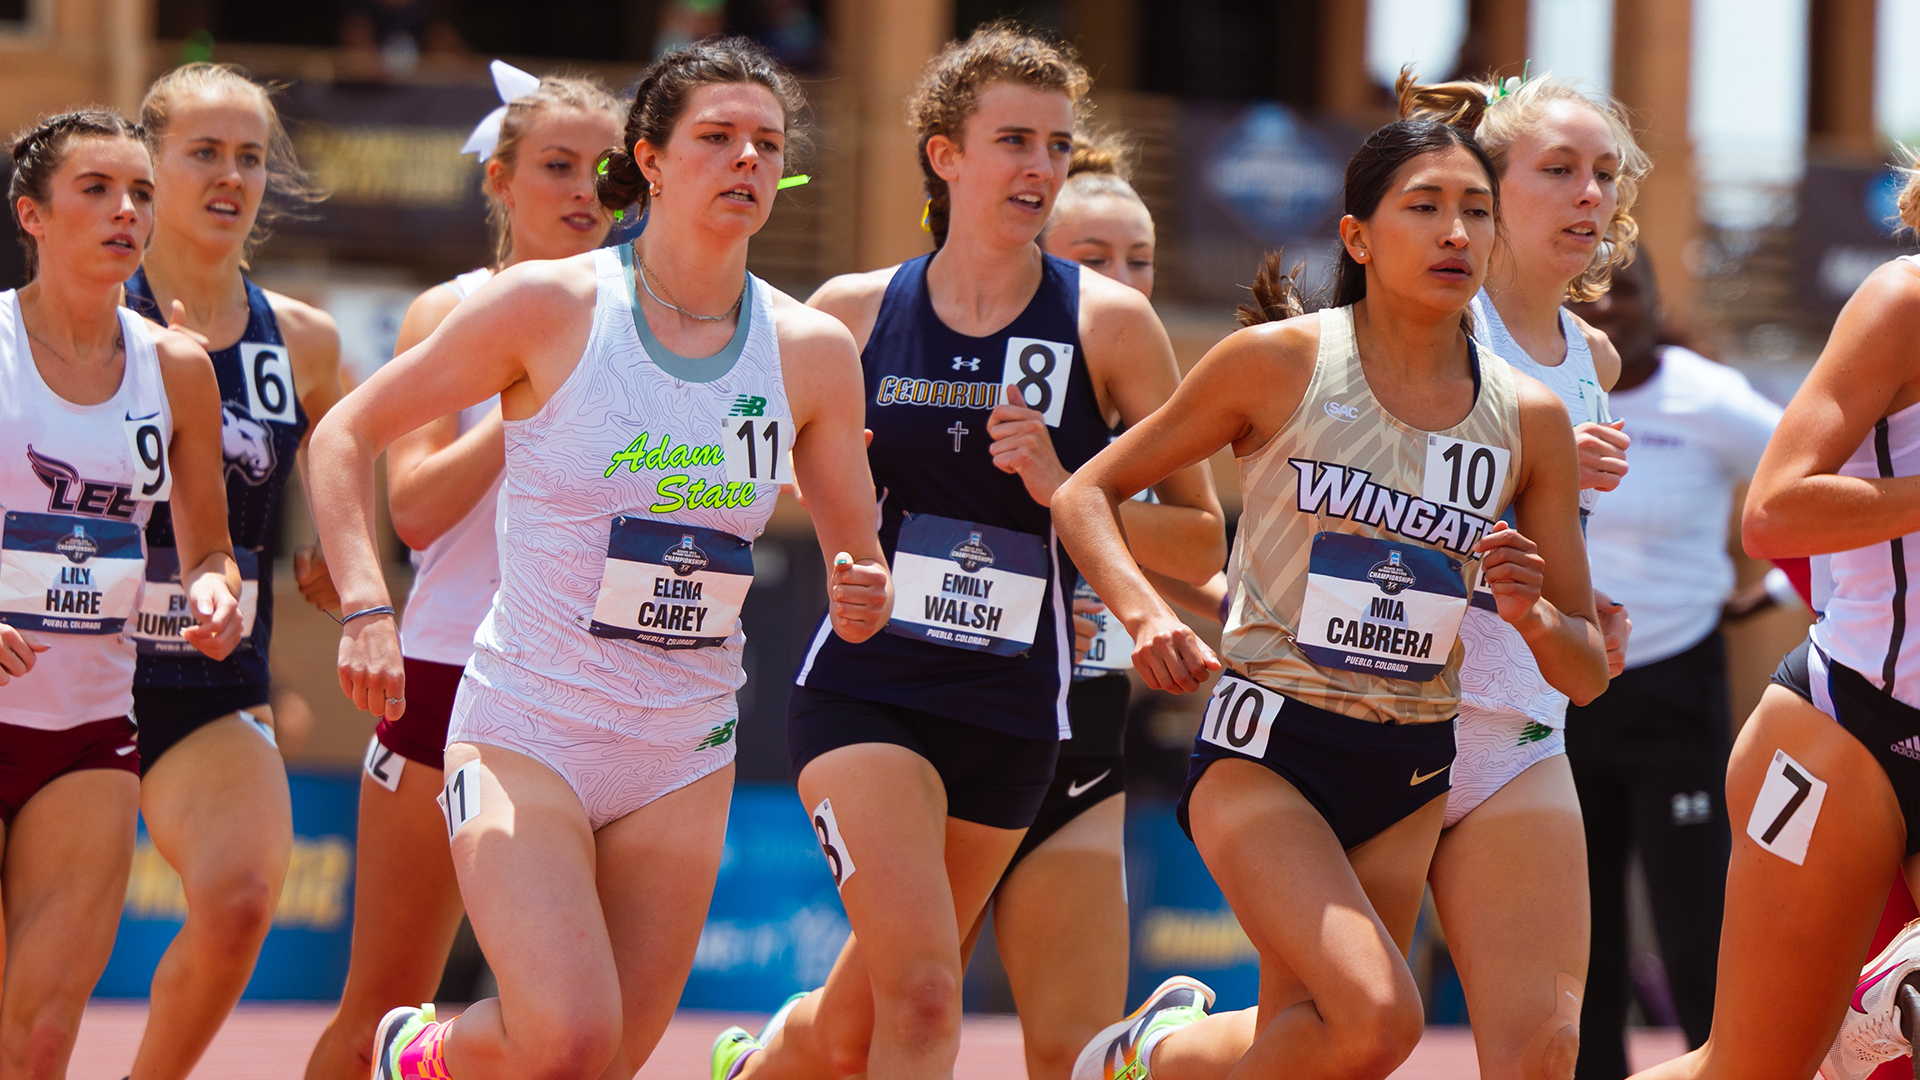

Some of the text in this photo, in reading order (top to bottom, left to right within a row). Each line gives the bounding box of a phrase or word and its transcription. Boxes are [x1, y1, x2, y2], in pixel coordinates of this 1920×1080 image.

[254, 350, 287, 415] 6
[876, 375, 1003, 410] CEDARVI
[1017, 344, 1056, 415] 8
[1328, 401, 1359, 420] SAC
[136, 424, 166, 496] 9
[604, 431, 726, 478] Adam
[736, 420, 778, 480] 11
[1442, 442, 1496, 510] 10
[48, 476, 141, 520] LEE
[650, 474, 757, 514] State
[664, 554, 708, 567] CHAMPIONSHIPS
[951, 550, 994, 565] CHAMPIONSHIPS
[61, 566, 91, 585] LILY
[653, 577, 703, 600] ELENA
[942, 573, 994, 599] EMILY
[1369, 571, 1415, 585] CHAMPIONSHIPS
[46, 589, 102, 614] HARE
[169, 595, 188, 611] EV
[925, 595, 1003, 632] WALSH
[1370, 597, 1404, 622] MIA
[42, 618, 102, 631] PUEBLO, COLORADO
[637, 602, 708, 632] CAREY
[637, 633, 697, 646] PUEBLO, COLORADO
[926, 629, 990, 647] PUEBLO, COLORADO
[1326, 617, 1433, 658] CABRERA
[1344, 655, 1408, 673] PUEBLO, COLORADO
[1212, 681, 1264, 748] 10
[1761, 763, 1812, 846] 7
